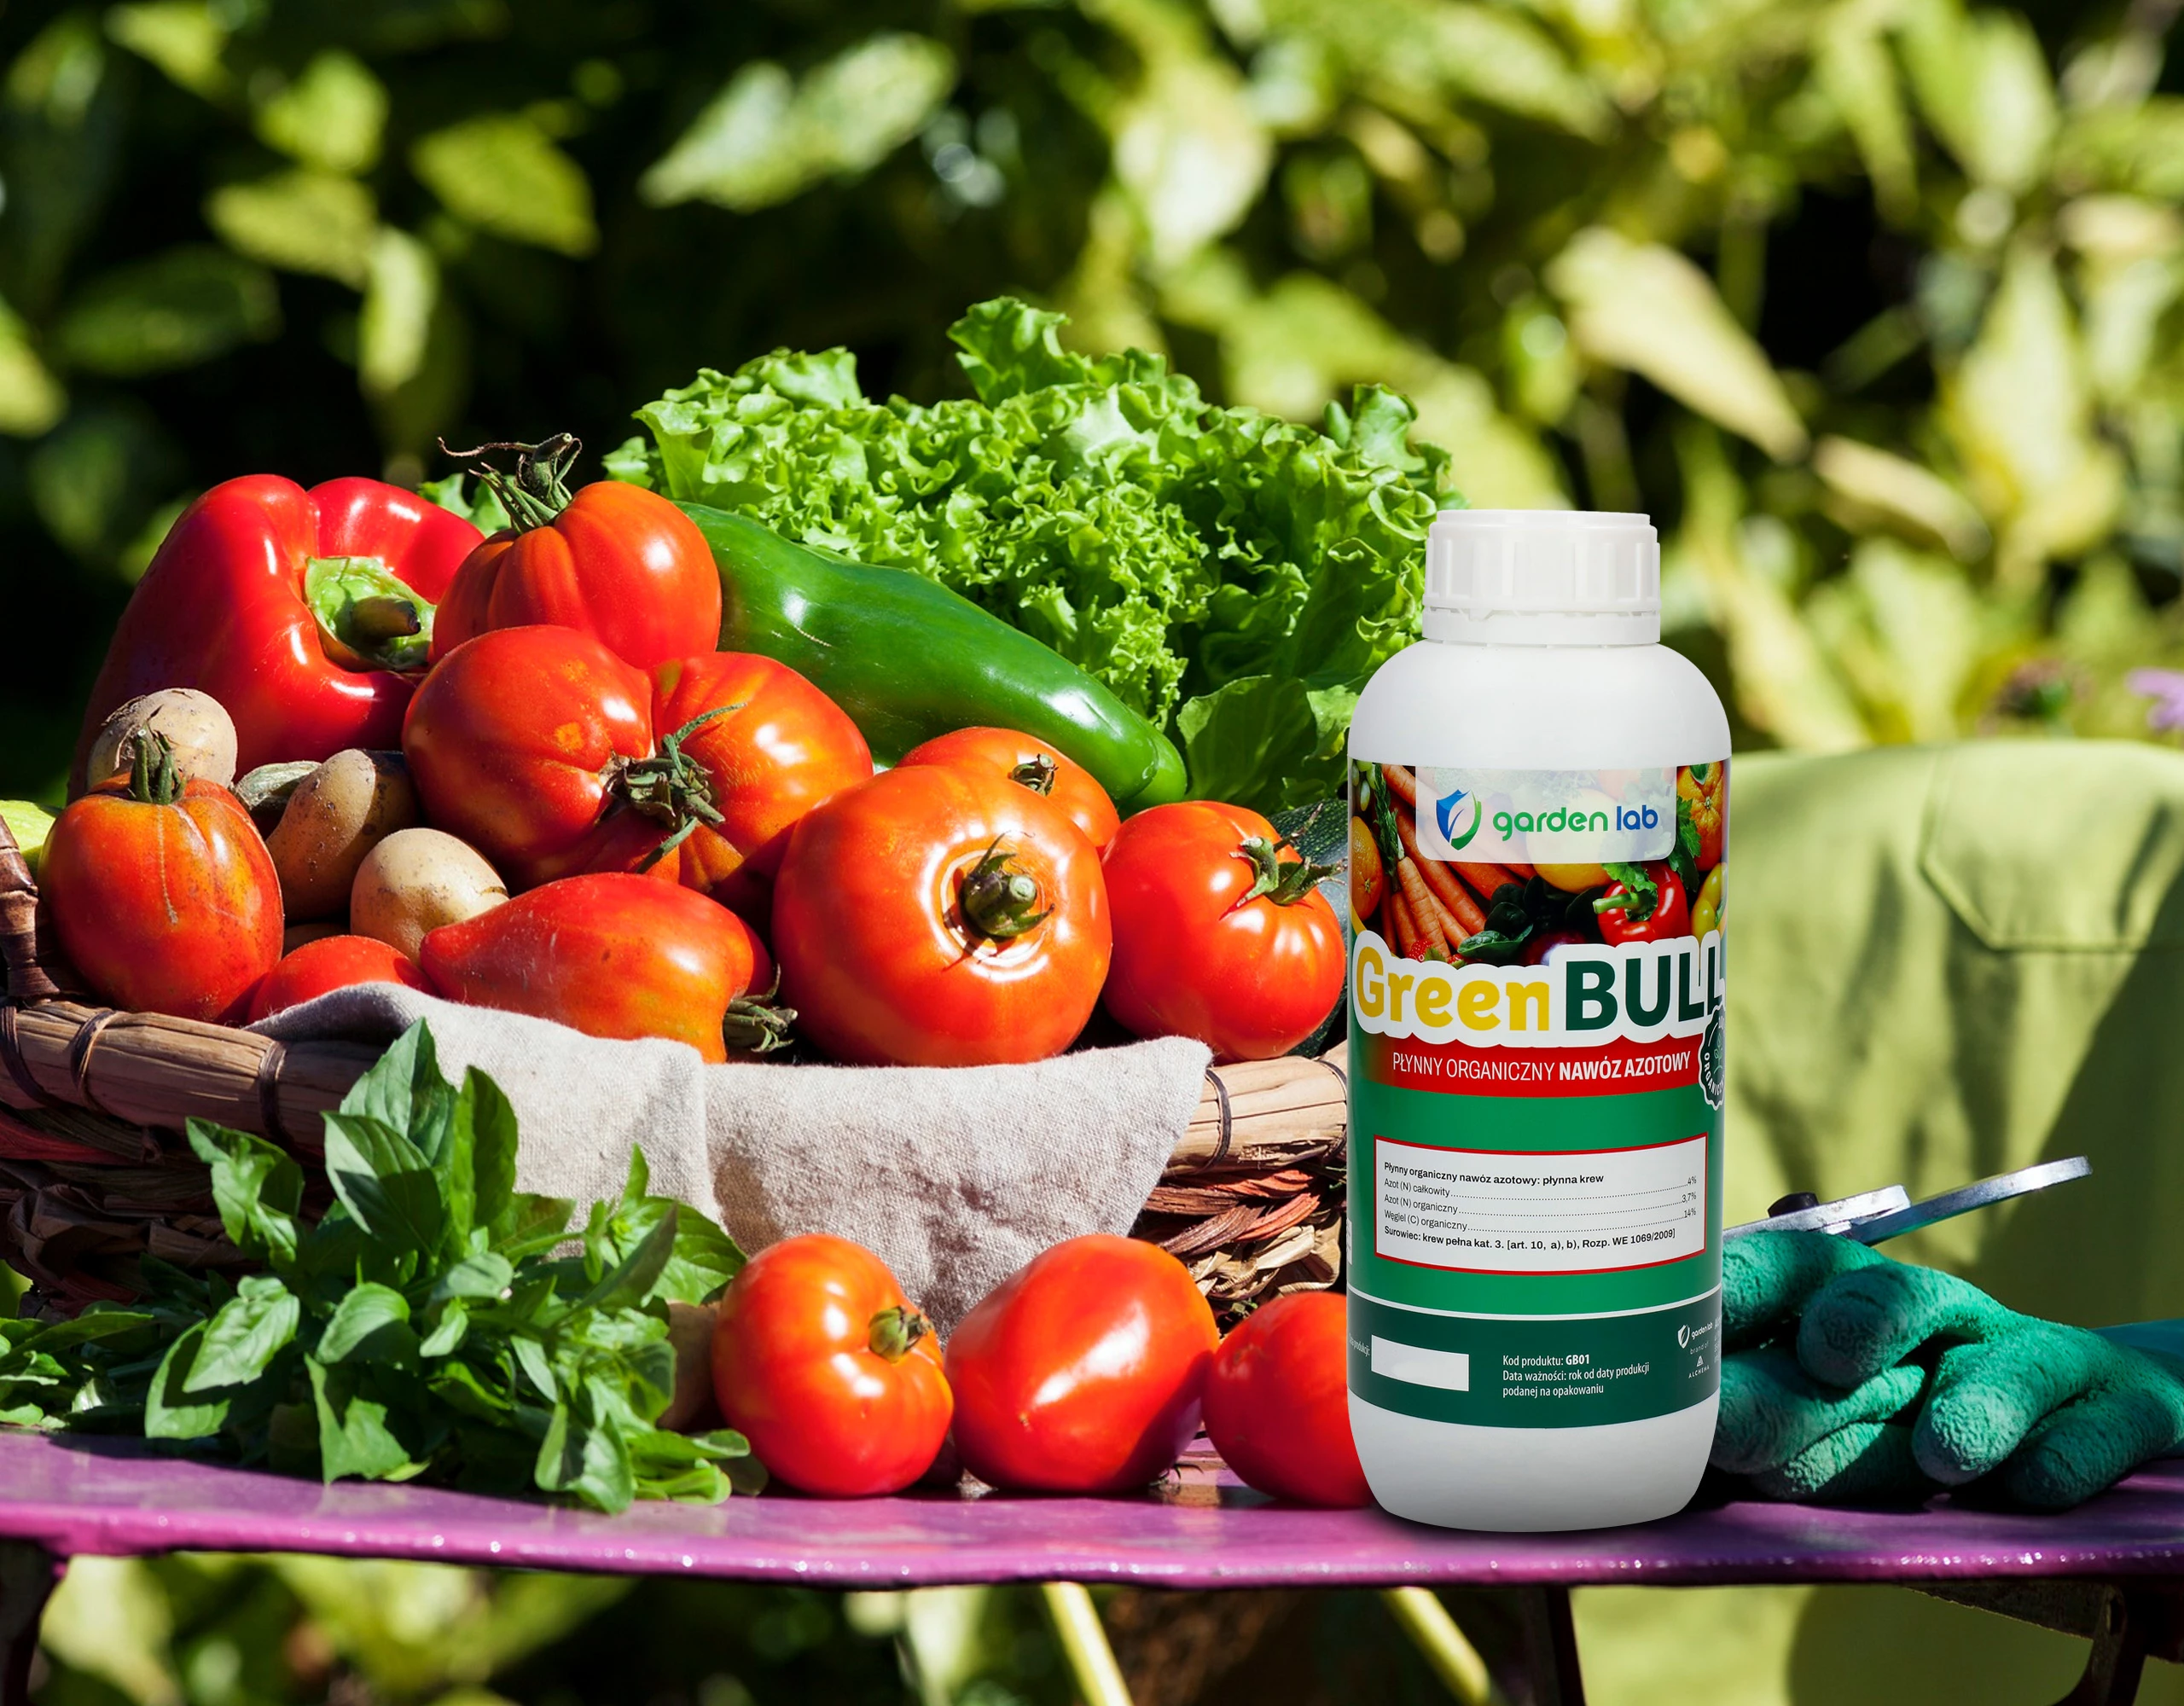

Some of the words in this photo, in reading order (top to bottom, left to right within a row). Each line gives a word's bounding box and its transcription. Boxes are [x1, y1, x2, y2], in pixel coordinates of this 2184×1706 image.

[1492, 806, 1608, 841] garden
[1616, 805, 1658, 832] lab
[1356, 946, 1550, 1031] Green
[1565, 946, 1722, 1031] BULL
[1393, 1052, 1443, 1076] PŁYNNY
[1446, 1059, 1555, 1081] ORGANICZNY
[1559, 1055, 1622, 1081] NAWÓZ
[1623, 1051, 1691, 1077] AZOTOWY
[1384, 1162, 1408, 1176] Płynny
[1409, 1169, 1457, 1183] organiczny
[1459, 1174, 1492, 1184] nawóz
[1493, 1175, 1540, 1187] azotowy:
[1542, 1175, 1577, 1187] płynna
[1579, 1175, 1605, 1183] krew
[1687, 1175, 1697, 1186] 4%
[1384, 1178, 1399, 1188] Azot
[1400, 1181, 1412, 1192] (N)
[1413, 1184, 1450, 1198] całkowity
[1682, 1192, 1697, 1204] 3,7%
[1384, 1194, 1399, 1204] Azot
[1400, 1197, 1412, 1208] (N)
[1413, 1201, 1458, 1215] organiczny
[1684, 1208, 1696, 1218] 14%
[1384, 1210, 1406, 1222] Węgiel
[1407, 1214, 1420, 1226] (C)
[1420, 1218, 1467, 1232] organiczny
[1384, 1226, 1421, 1241] Surowiec:
[1422, 1233, 1443, 1244] krew
[1445, 1237, 1472, 1246] pełna
[1474, 1238, 1492, 1248] kat.
[1495, 1239, 1504, 1249] 3.
[1507, 1239, 1528, 1250] [art.
[1531, 1240, 1546, 1250] 10,
[1550, 1240, 1564, 1250] a),
[1566, 1239, 1580, 1250] b),
[1582, 1239, 1610, 1248] Rozp.
[1612, 1236, 1629, 1245] WE
[1630, 1228, 1676, 1244] 1069/2009]
[1502, 1355, 1519, 1366] Kod
[1521, 1355, 1564, 1368] produktu:
[1565, 1354, 1589, 1366] GB01
[1502, 1370, 1523, 1381] Data
[1525, 1370, 1566, 1382] ważności:
[1568, 1369, 1582, 1380] rok
[1583, 1368, 1594, 1379] od
[1596, 1367, 1614, 1379] daty
[1616, 1362, 1650, 1378] produkcji
[1502, 1385, 1537, 1398] podanej
[1540, 1387, 1551, 1396] na
[1553, 1384, 1604, 1398] opakowaniu
